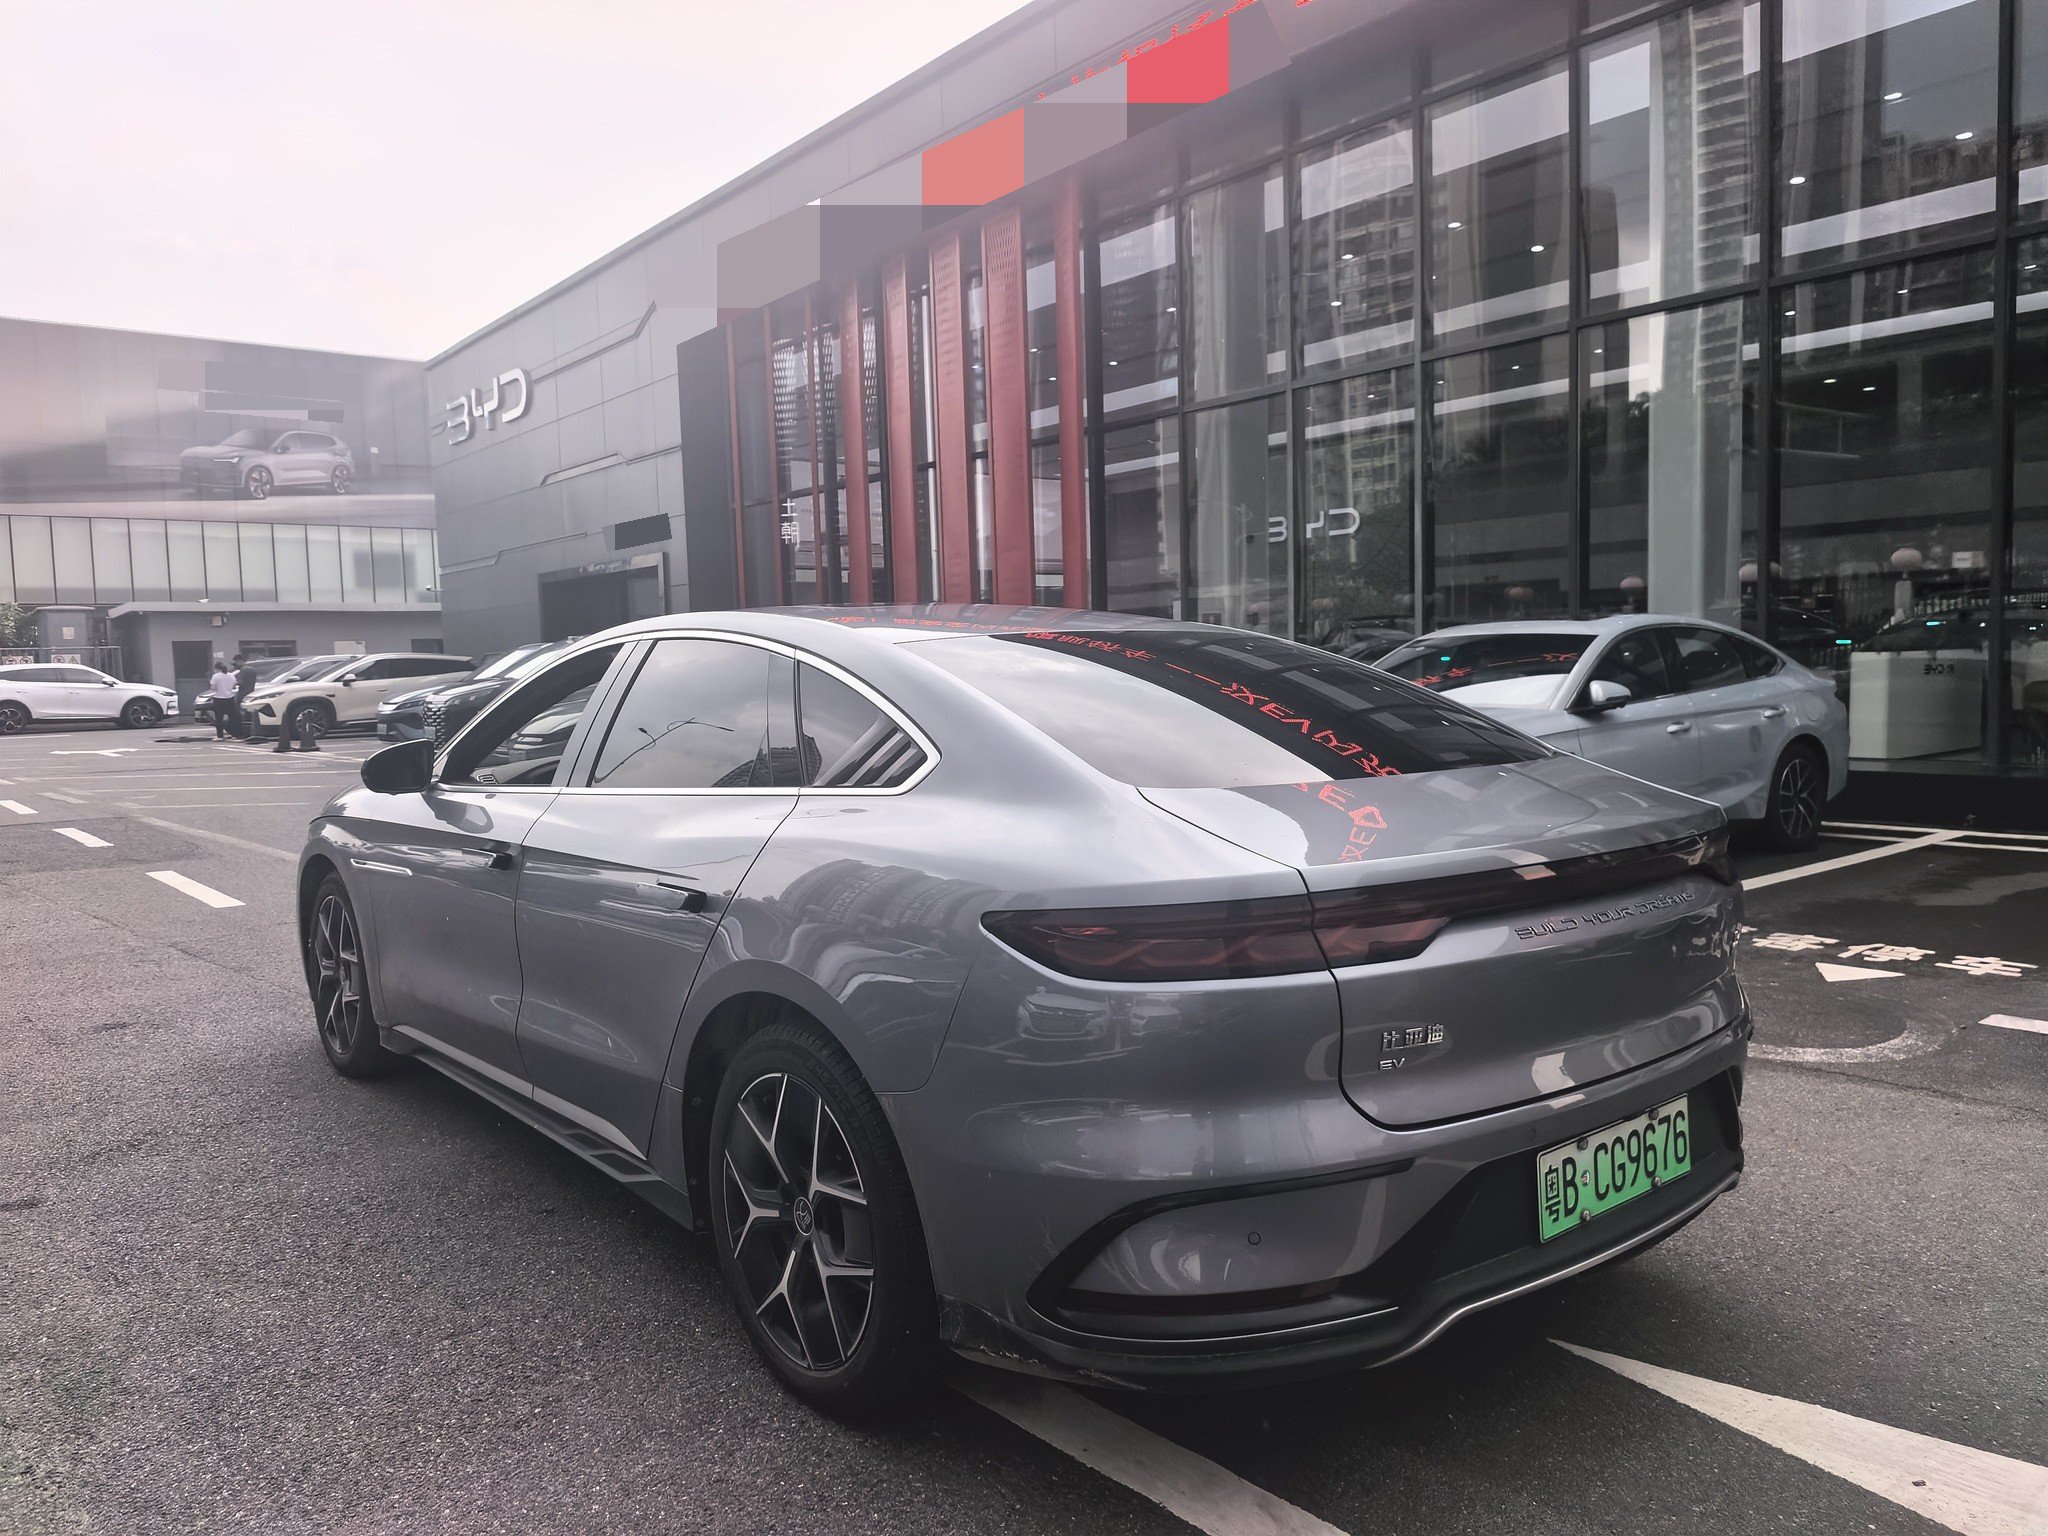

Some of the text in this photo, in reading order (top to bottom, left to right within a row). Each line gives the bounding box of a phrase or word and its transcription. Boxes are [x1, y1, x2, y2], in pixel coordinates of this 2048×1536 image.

[446, 367, 527, 445] BYD
[1514, 891, 1696, 940] BUILD YOUR DREAMS
[1382, 1023, 1444, 1051] 比亚迪
[1379, 1057, 1405, 1071] EV
